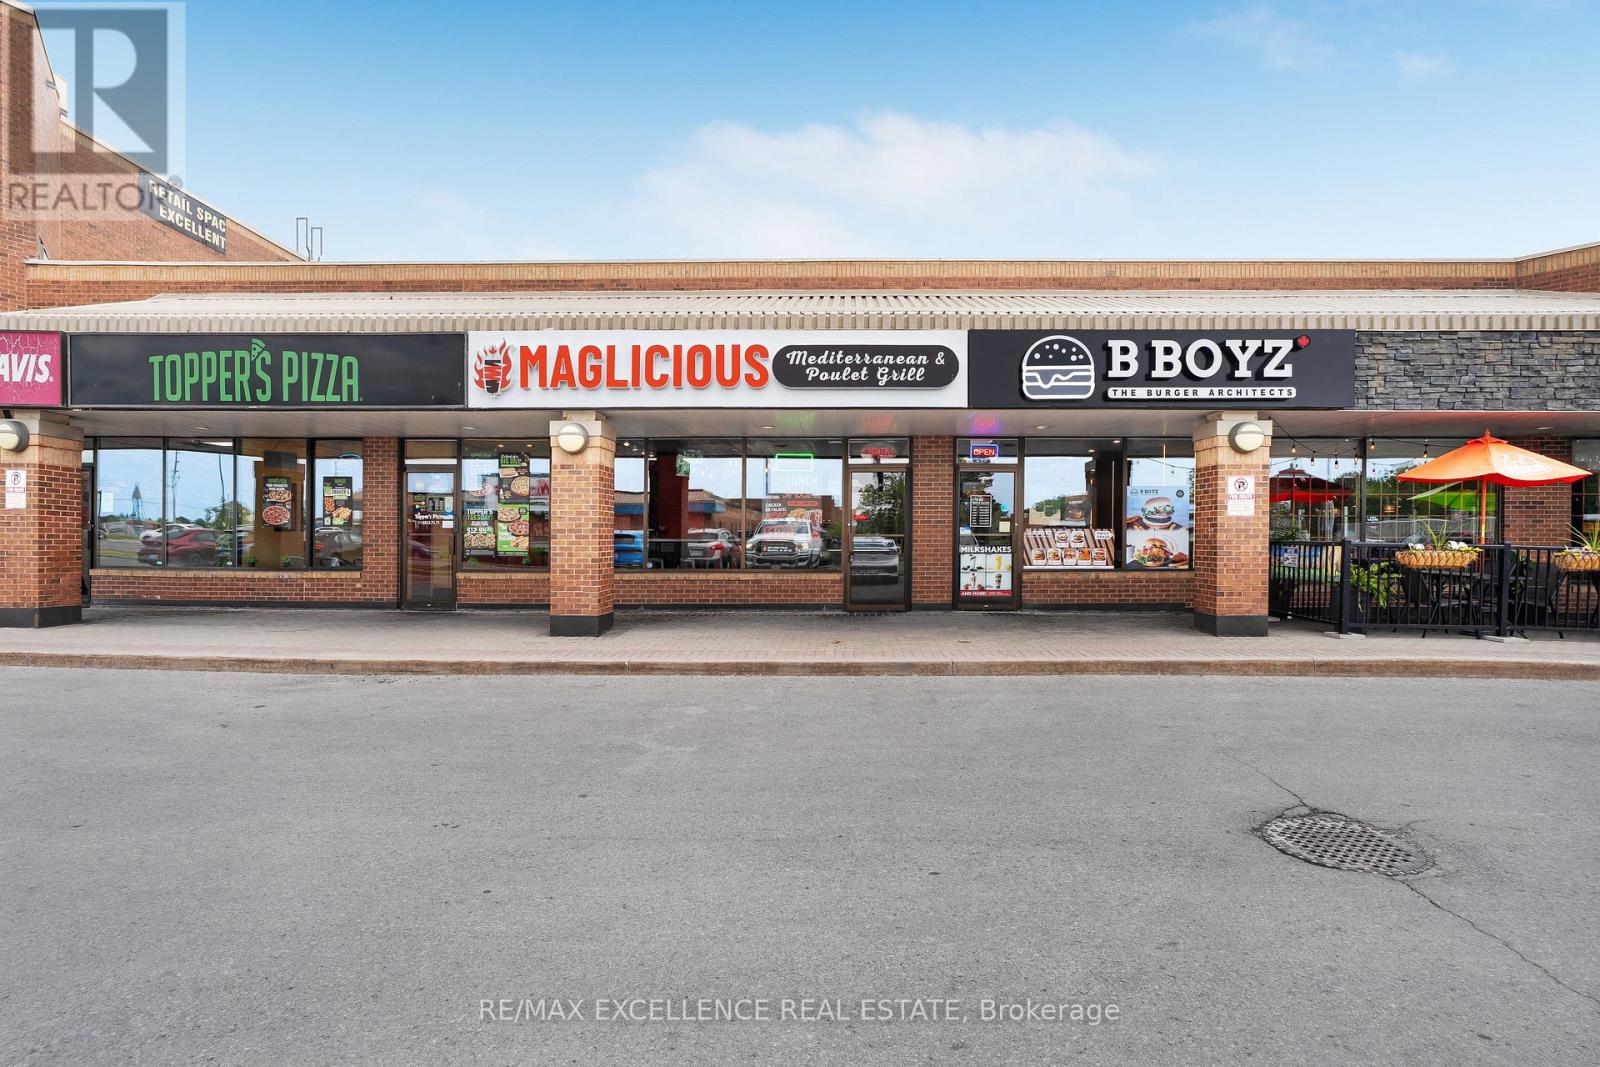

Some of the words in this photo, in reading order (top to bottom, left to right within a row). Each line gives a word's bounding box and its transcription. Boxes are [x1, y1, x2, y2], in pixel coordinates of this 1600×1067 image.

[149, 180, 193, 215] RETAIL
[196, 206, 226, 233] SPAC
[159, 204, 227, 249] EXCELLENT
[148, 338, 272, 402] TOPPER'S
[282, 350, 360, 402] PIZZA
[519, 344, 770, 390] MAGLICIOUS
[786, 350, 929, 366] Mediterranean
[935, 351, 945, 365] &
[805, 366, 869, 381] Poulet
[876, 366, 925, 386] Grill
[1107, 339, 1139, 378] B
[1151, 338, 1294, 378] BOYZ
[973, 448, 995, 456] OPEN
[960, 545, 1012, 553] MILKSHAKES
